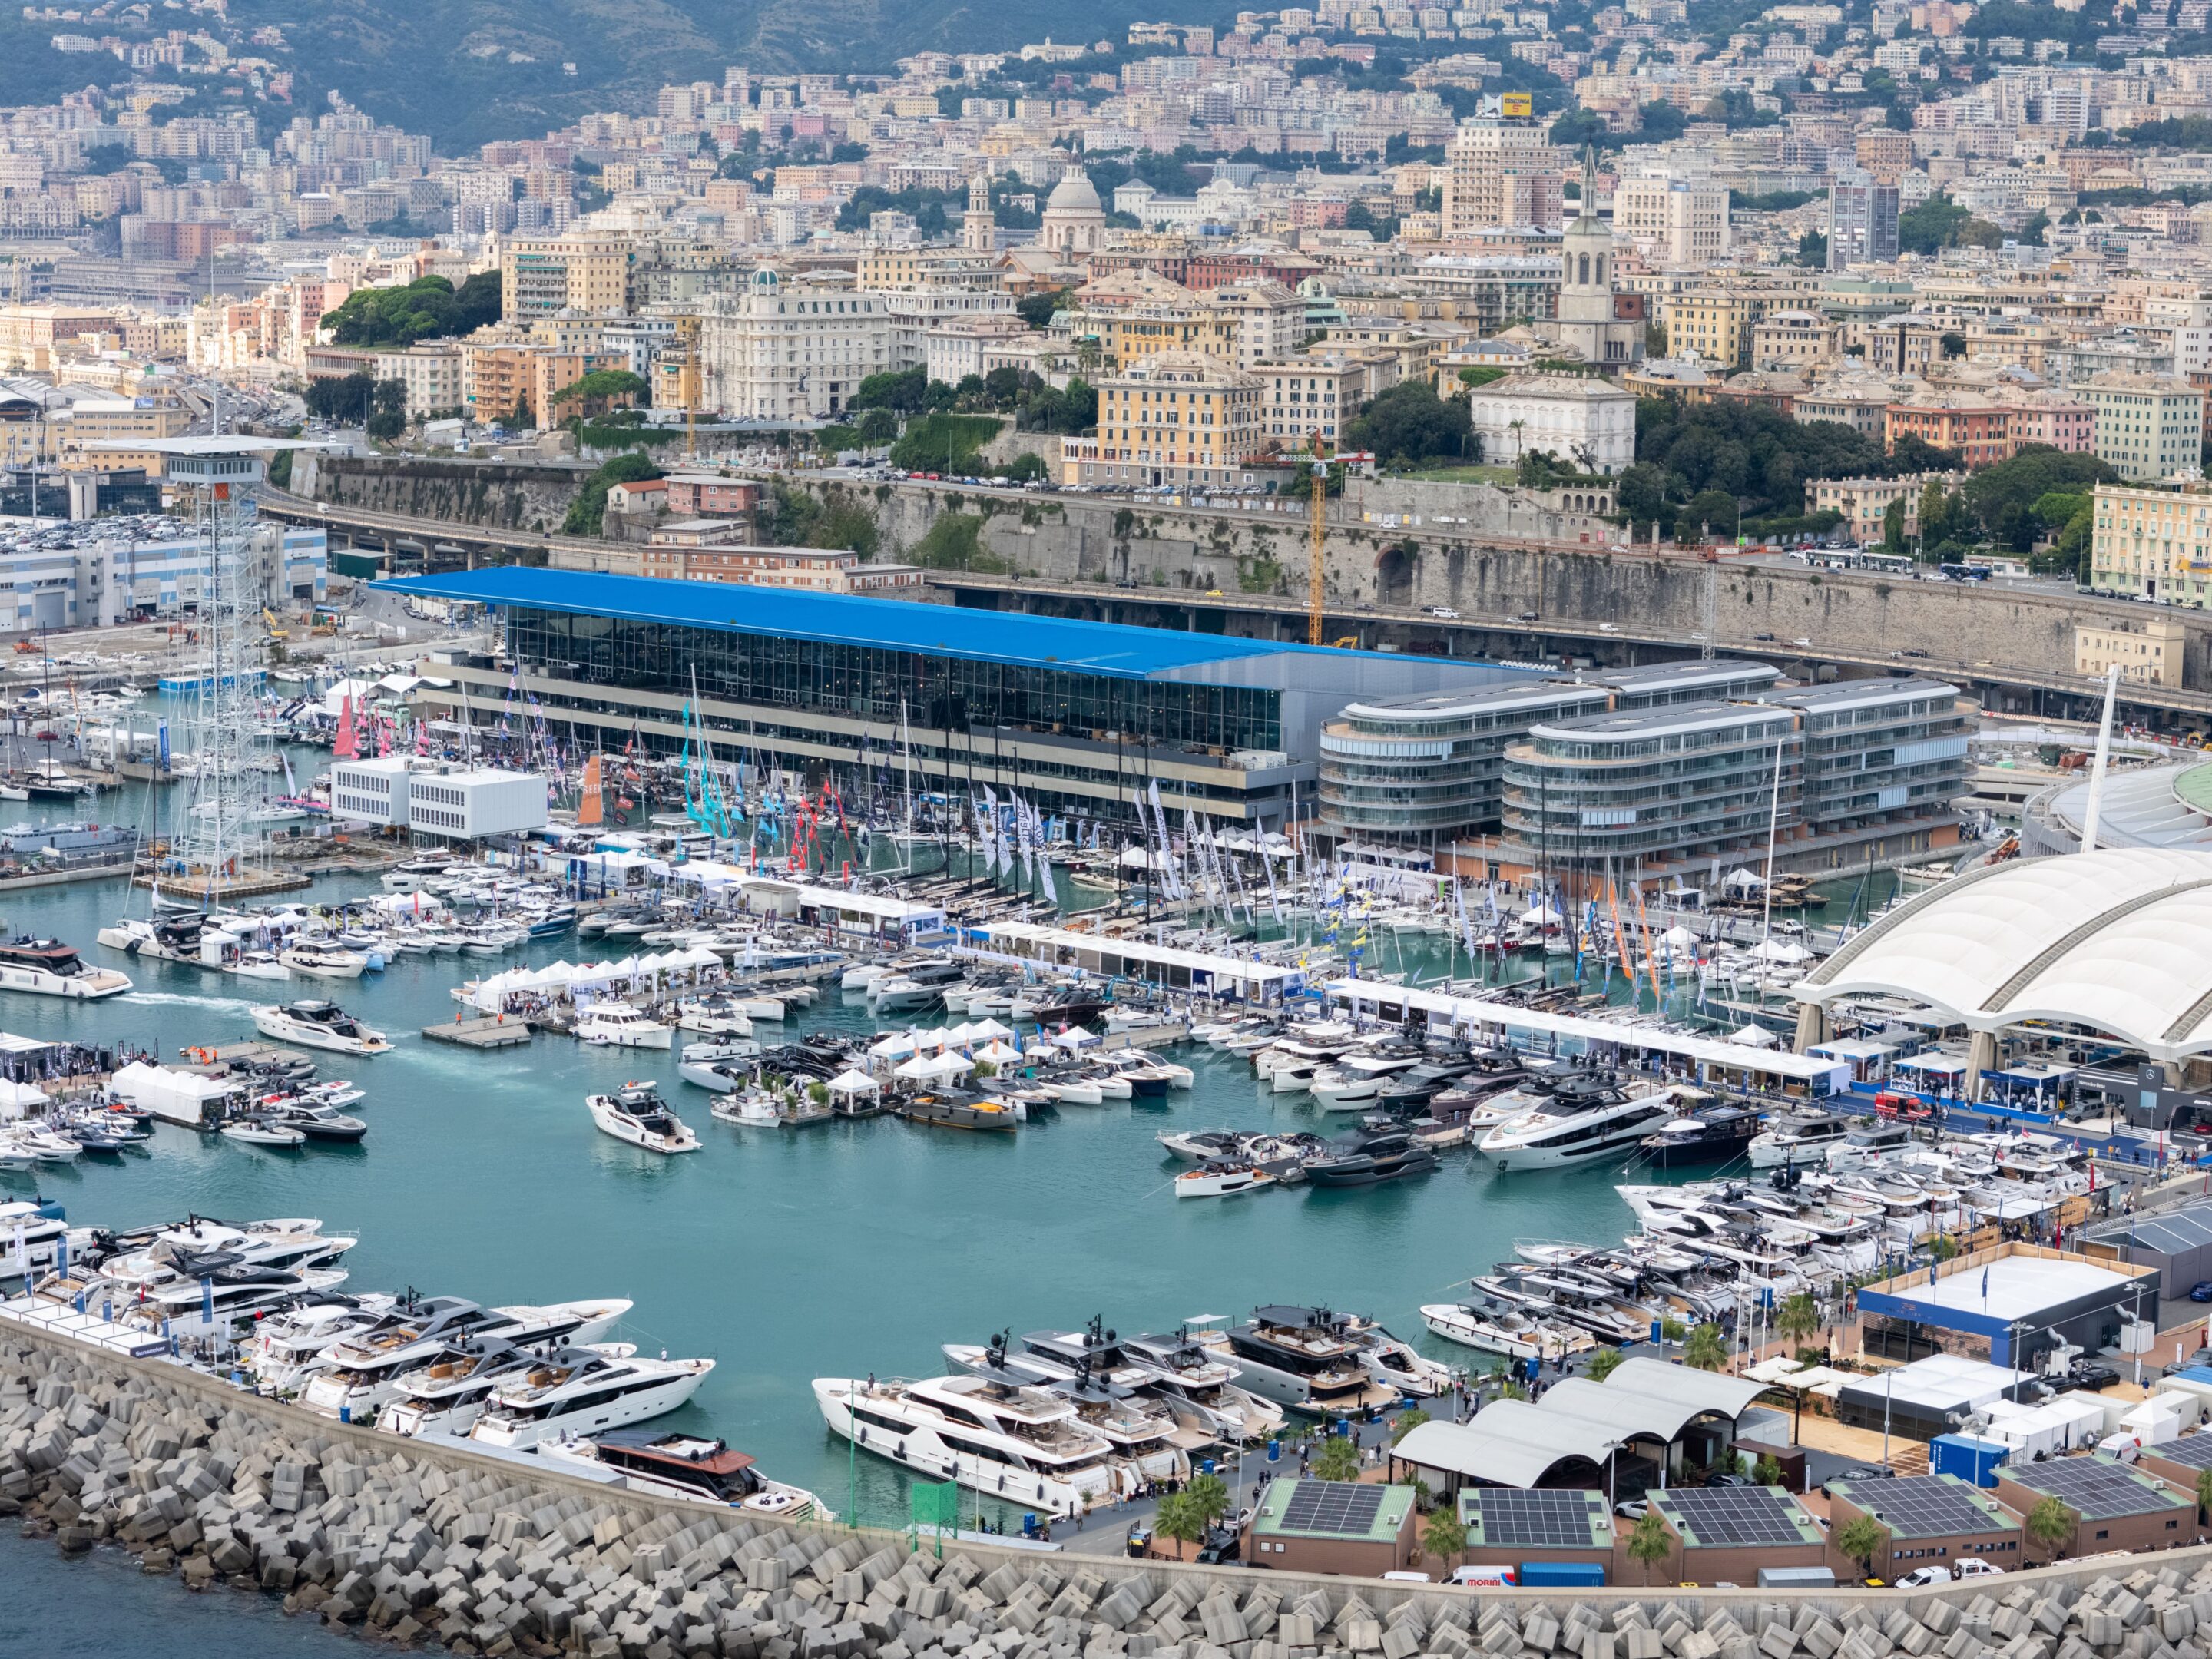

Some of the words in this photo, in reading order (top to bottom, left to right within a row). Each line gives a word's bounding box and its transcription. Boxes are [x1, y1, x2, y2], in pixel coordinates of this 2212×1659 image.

[2078, 1079, 2106, 1089] Mercedes-Benz
[135, 1346, 166, 1357] Sunseeker
[1467, 1578, 1501, 1587] MORINI
